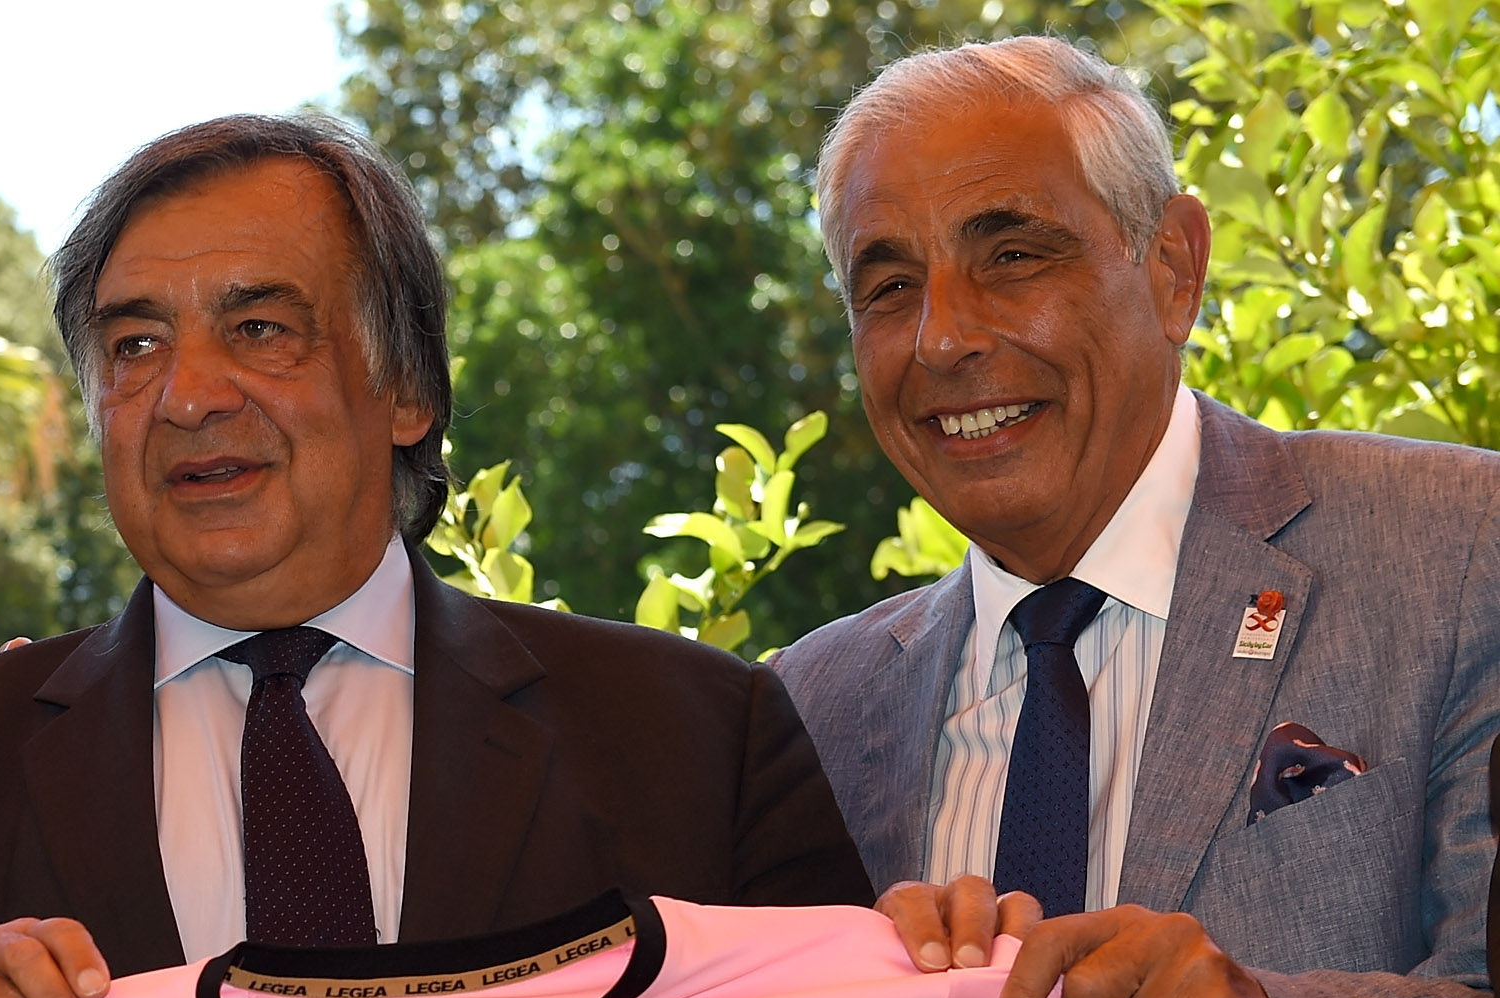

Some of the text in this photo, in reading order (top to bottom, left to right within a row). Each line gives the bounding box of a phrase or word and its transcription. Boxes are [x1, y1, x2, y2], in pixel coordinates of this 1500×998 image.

[248, 936, 612, 998] LEGEA LEGEA LEGEA LEGEA LEGEA
